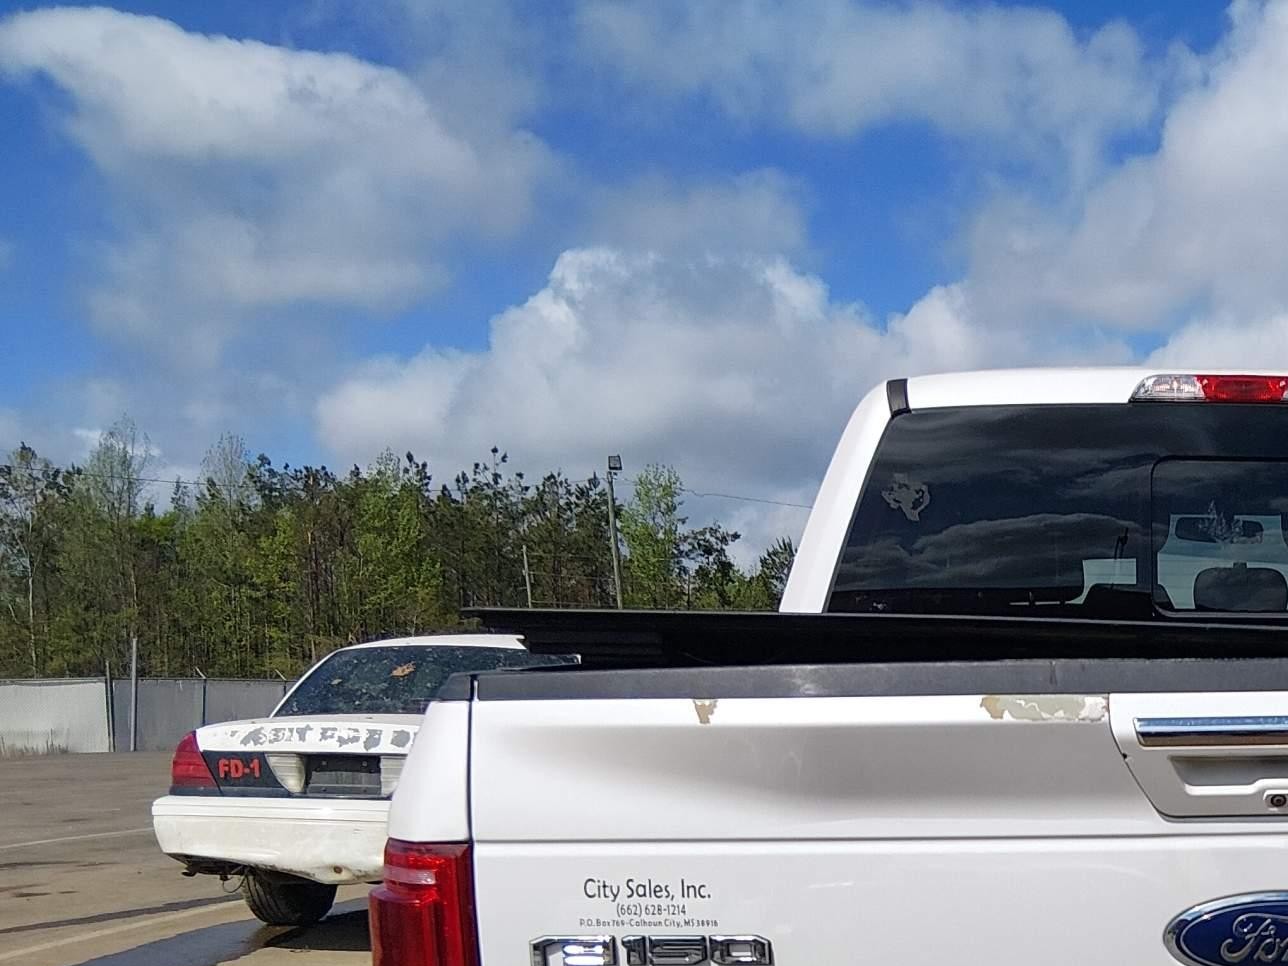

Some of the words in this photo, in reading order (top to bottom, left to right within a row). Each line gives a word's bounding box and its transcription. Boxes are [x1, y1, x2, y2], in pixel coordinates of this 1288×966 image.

[218, 757, 262, 779] FD-1
[583, 878, 621, 903] City
[625, 878, 675, 901] Sales,
[680, 878, 712, 899] Inc.
[616, 903, 642, 918] (662)
[644, 904, 686, 916] 628-1214
[579, 919, 595, 927] P.O.
[596, 919, 611, 927] Box
[663, 919, 683, 929] City,
[683, 919, 695, 927] MS
